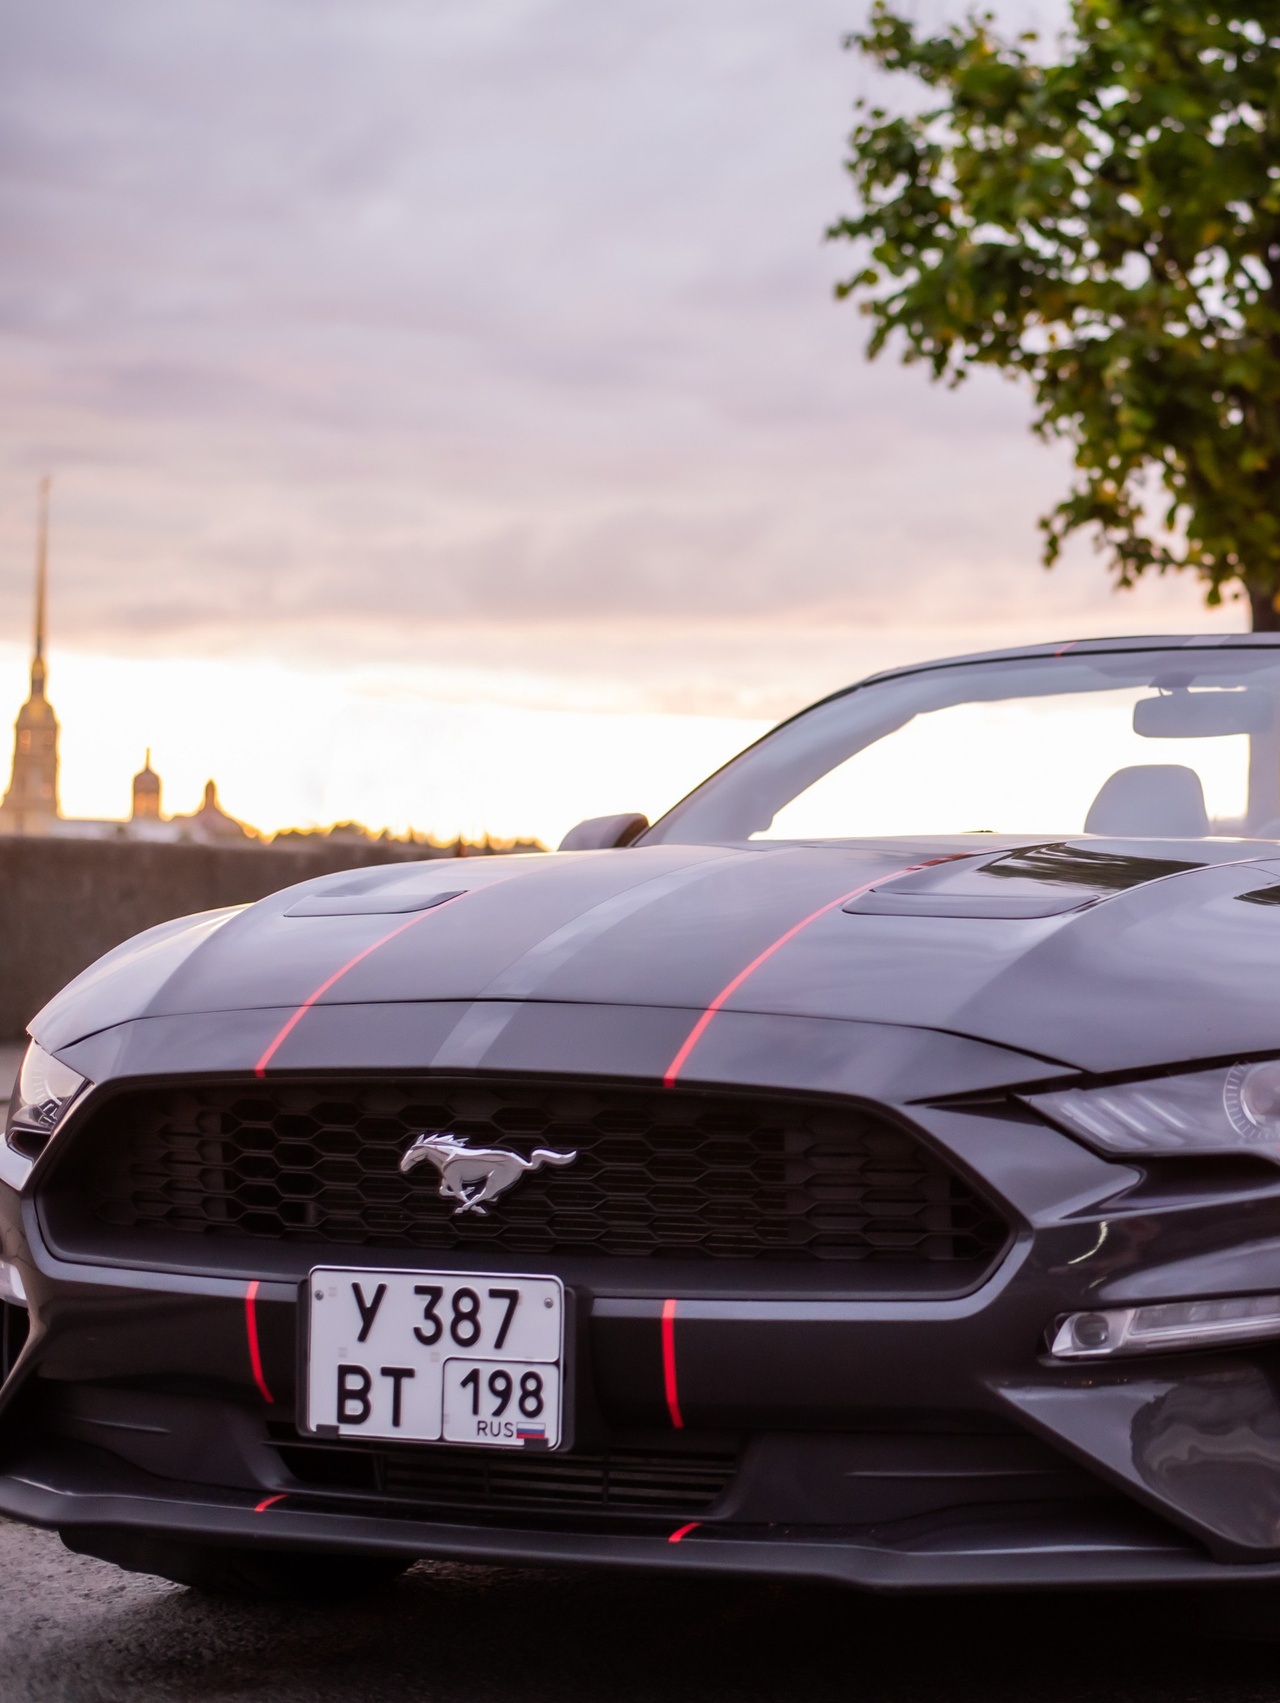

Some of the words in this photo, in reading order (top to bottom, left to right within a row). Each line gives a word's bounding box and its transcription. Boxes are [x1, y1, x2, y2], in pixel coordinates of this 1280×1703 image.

[413, 1285, 520, 1350] 387
[460, 1368, 544, 1419] 198
[476, 1420, 515, 1438] RUS
